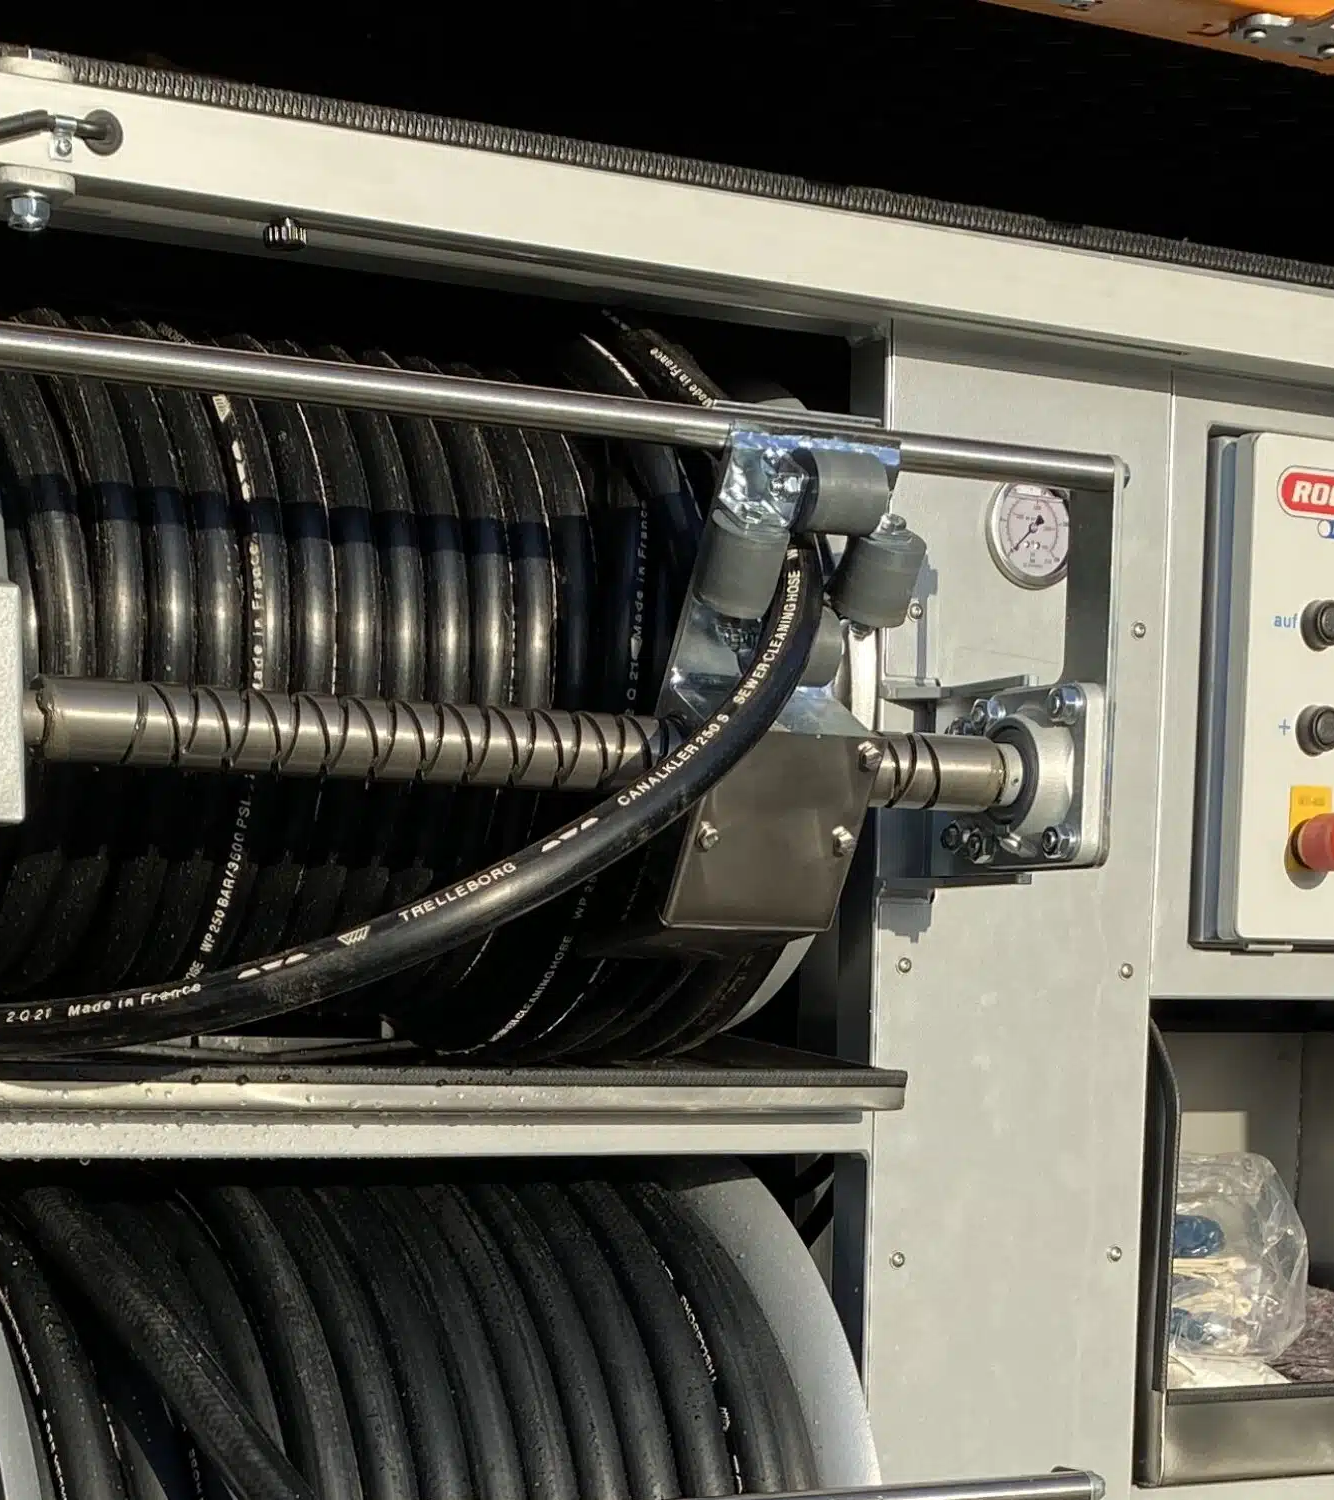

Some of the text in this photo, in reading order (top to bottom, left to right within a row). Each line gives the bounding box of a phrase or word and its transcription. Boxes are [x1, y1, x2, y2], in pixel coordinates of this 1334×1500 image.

[1273, 613, 1298, 629] auf
[617, 743, 699, 807] CANALKLER
[695, 724, 721, 746] 250
[717, 713, 730, 723] S
[733, 661, 770, 705] SEWER
[763, 603, 796, 661] CLEANING
[786, 569, 801, 602] HOSE
[398, 862, 517, 922] TRELLEBORG
[68, 1000, 112, 1017] Made
[118, 995, 134, 1010] in
[140, 982, 203, 1005] France
